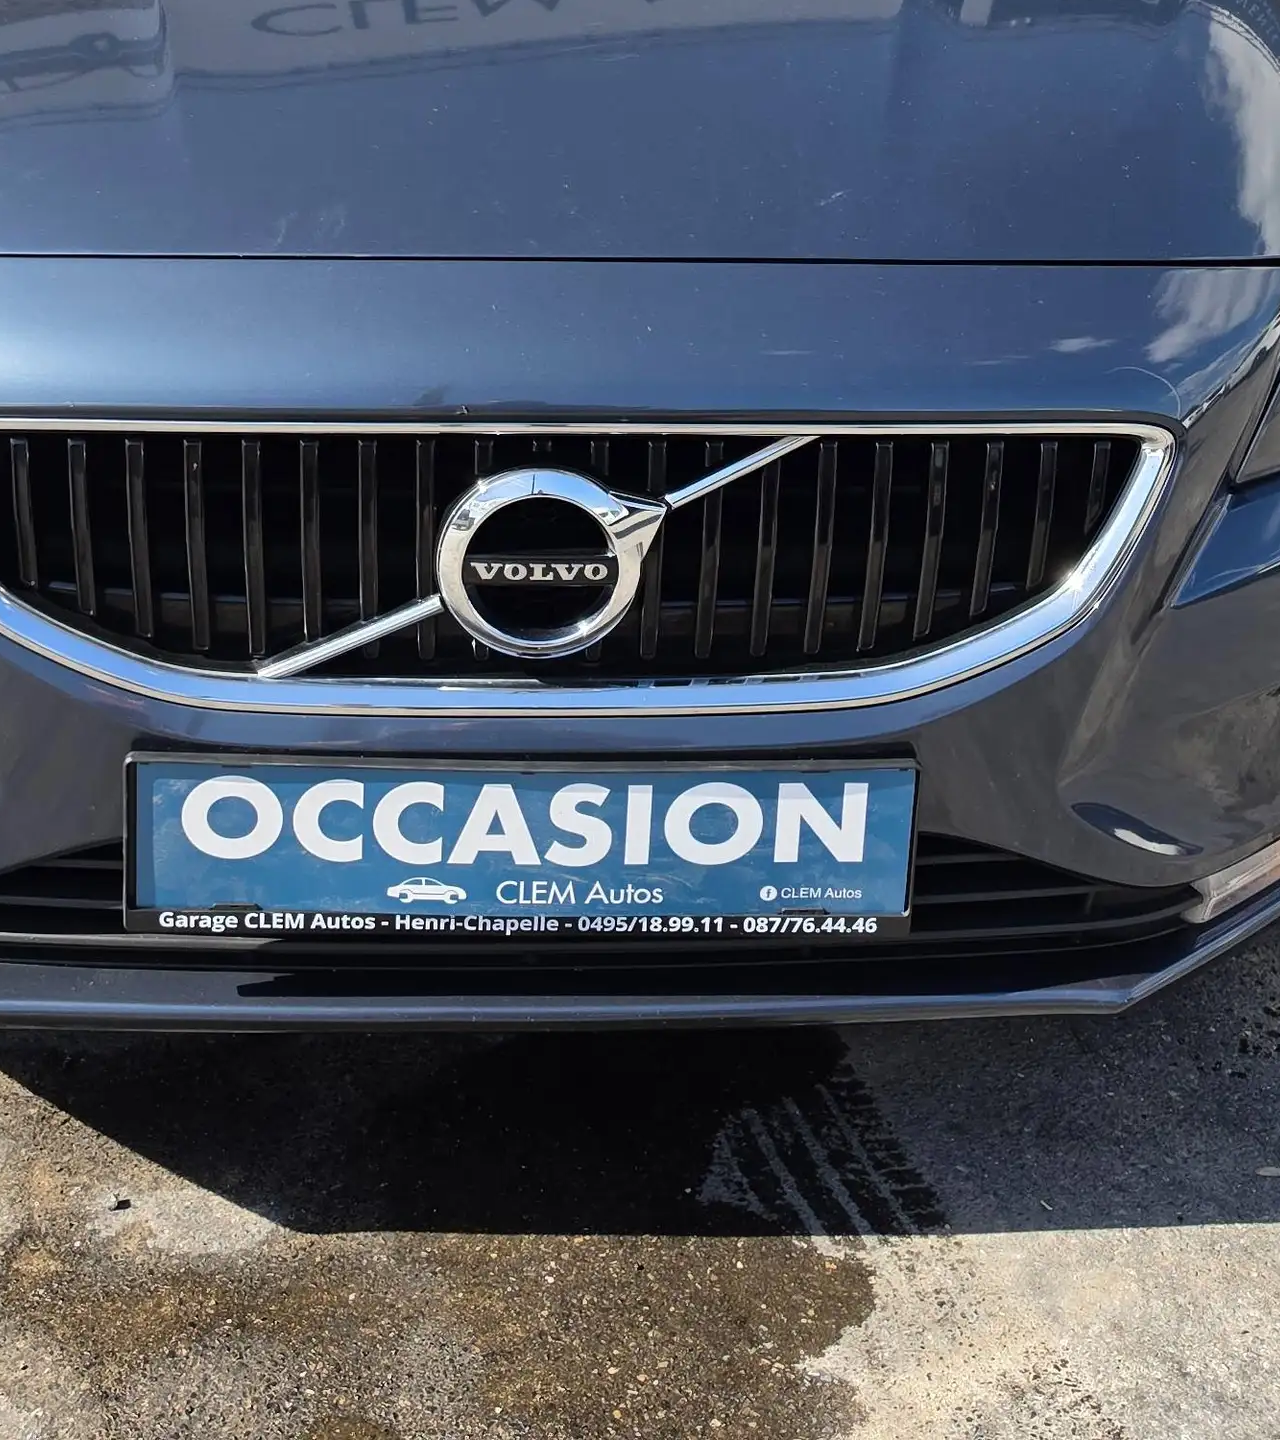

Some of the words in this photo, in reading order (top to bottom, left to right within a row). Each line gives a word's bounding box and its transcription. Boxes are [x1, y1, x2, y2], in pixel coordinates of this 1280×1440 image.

[470, 562, 608, 581] VOLVO
[181, 775, 869, 867] OCCASION
[496, 880, 576, 905] CLEM
[585, 880, 664, 906] Autos
[781, 887, 822, 900] CLEM
[824, 887, 862, 900] Autos
[159, 912, 239, 932] Garage
[244, 913, 306, 930] CLEM
[311, 913, 377, 931] Autos
[395, 913, 559, 936] Henri-Chapelle
[578, 916, 723, 933] 0495/18.99.11
[743, 916, 878, 934] 087/76.44.46
